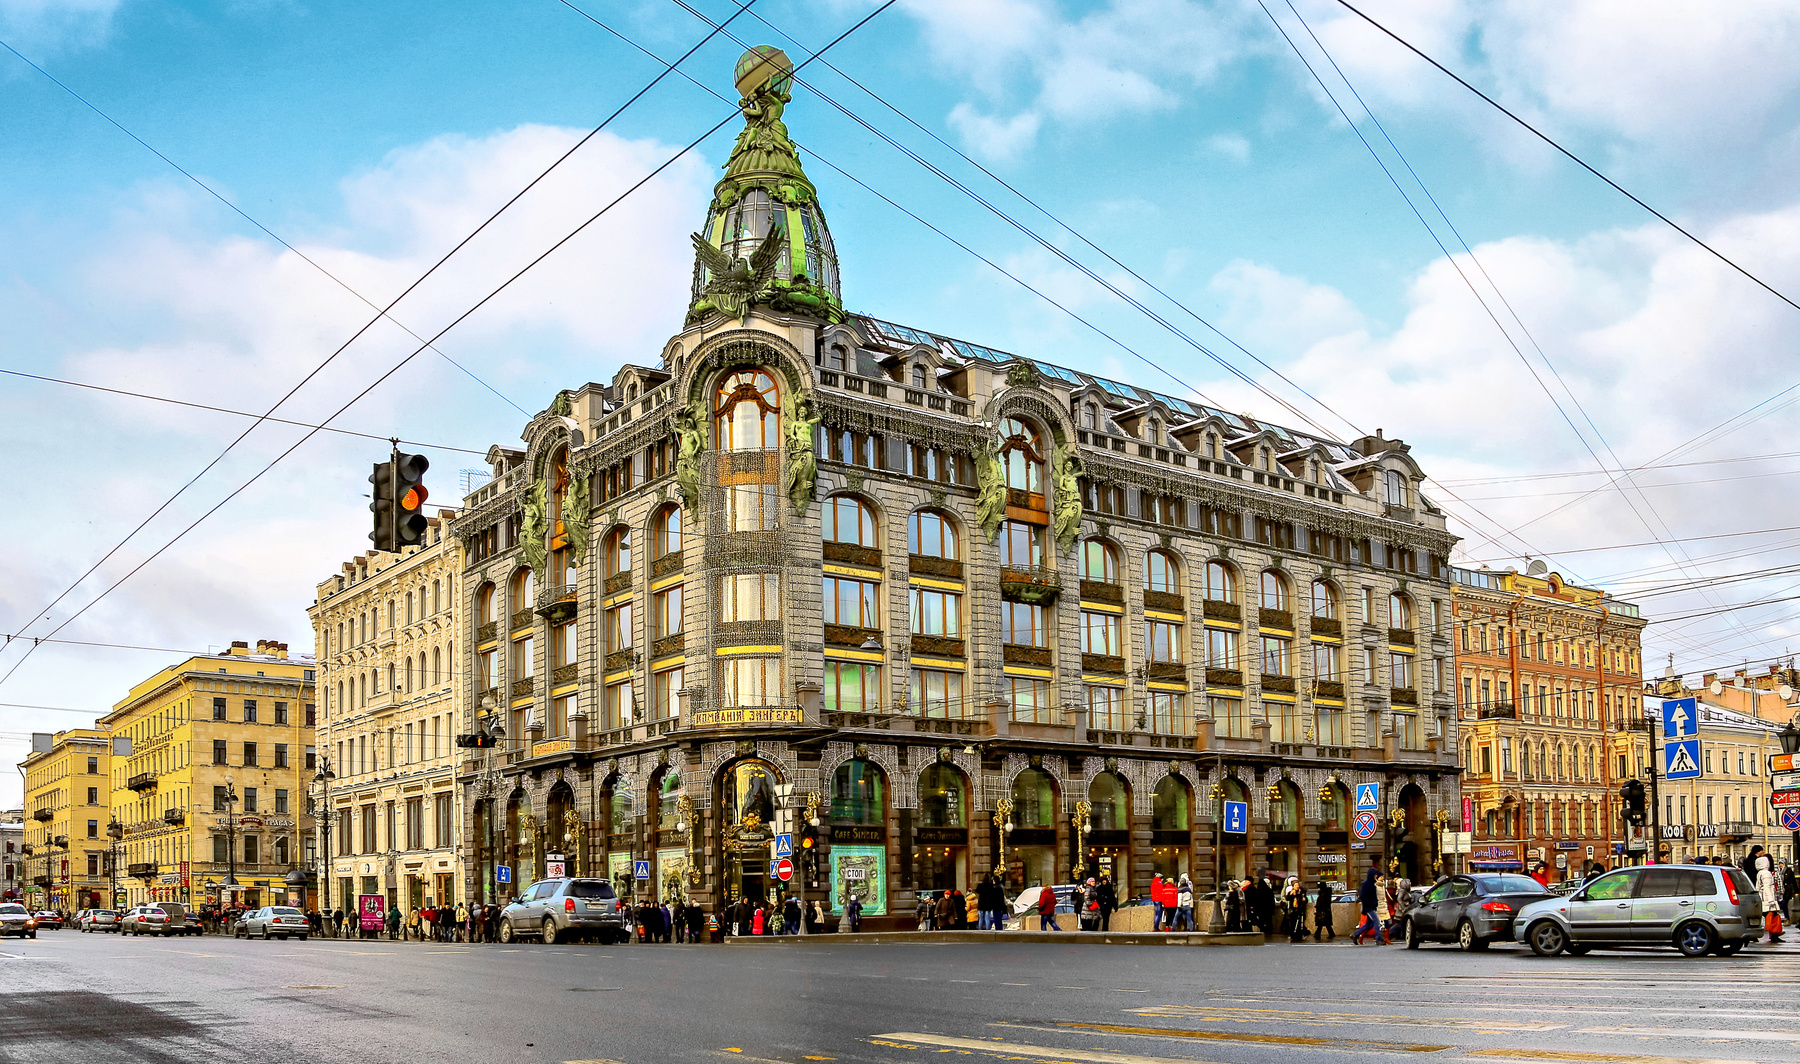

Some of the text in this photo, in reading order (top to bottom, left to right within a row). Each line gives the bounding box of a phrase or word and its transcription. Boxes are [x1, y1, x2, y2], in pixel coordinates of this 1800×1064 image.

[1662, 825, 1718, 838] КОФЕ ХАУЗ
[1317, 854, 1347, 863] SOUVENIRS
[846, 869, 863, 878] СТОП
